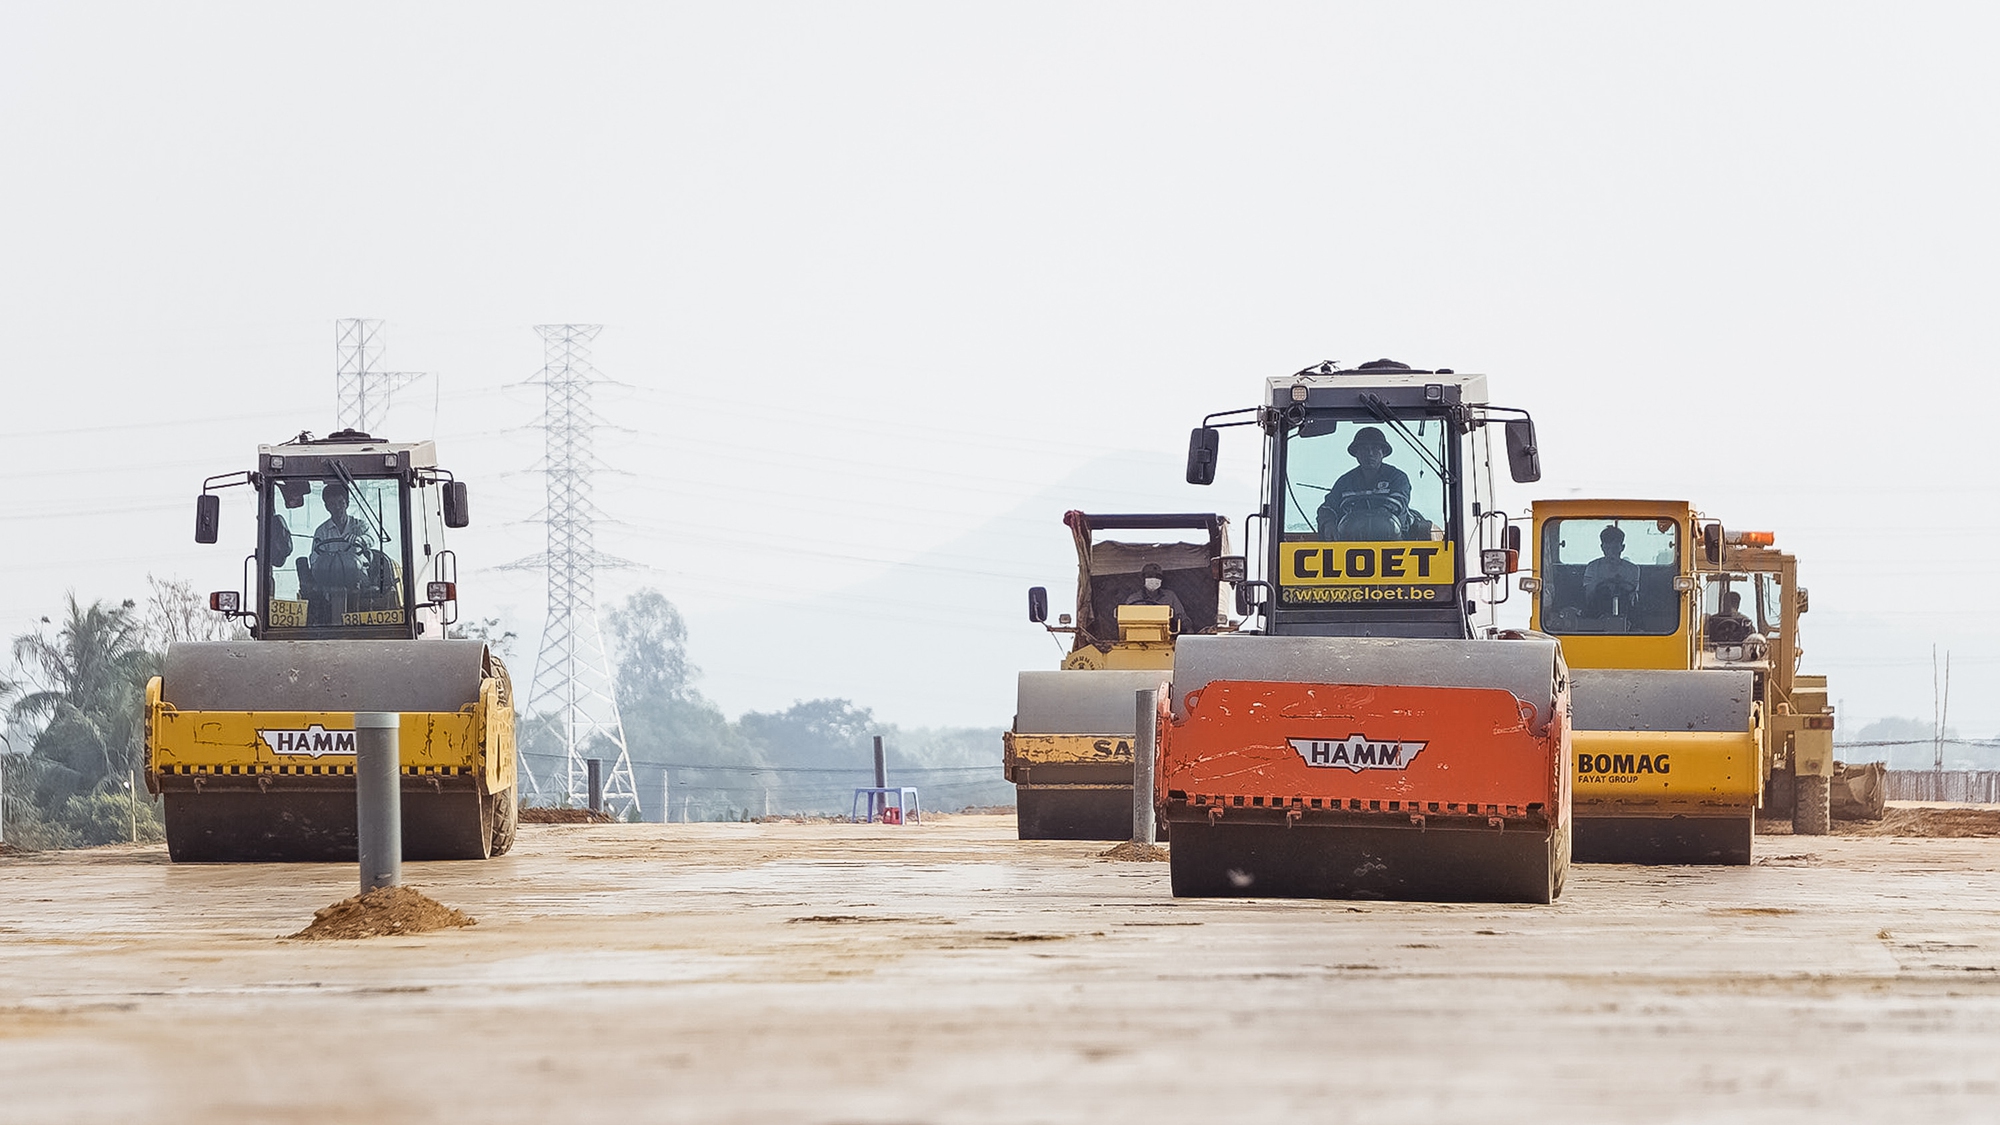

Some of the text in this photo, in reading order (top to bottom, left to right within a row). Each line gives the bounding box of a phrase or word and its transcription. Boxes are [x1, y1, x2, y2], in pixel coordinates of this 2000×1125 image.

[1294, 548, 1439, 578] CLOET
[1295, 587, 1435, 600] www.cloet.be
[271, 614, 299, 627] 0291
[278, 733, 355, 751] HAMM
[1093, 739, 1135, 759] SA
[1311, 742, 1402, 765] HAMM
[1578, 754, 1670, 774] BOMAG
[1578, 775, 1638, 783] FAYAT GROUP
